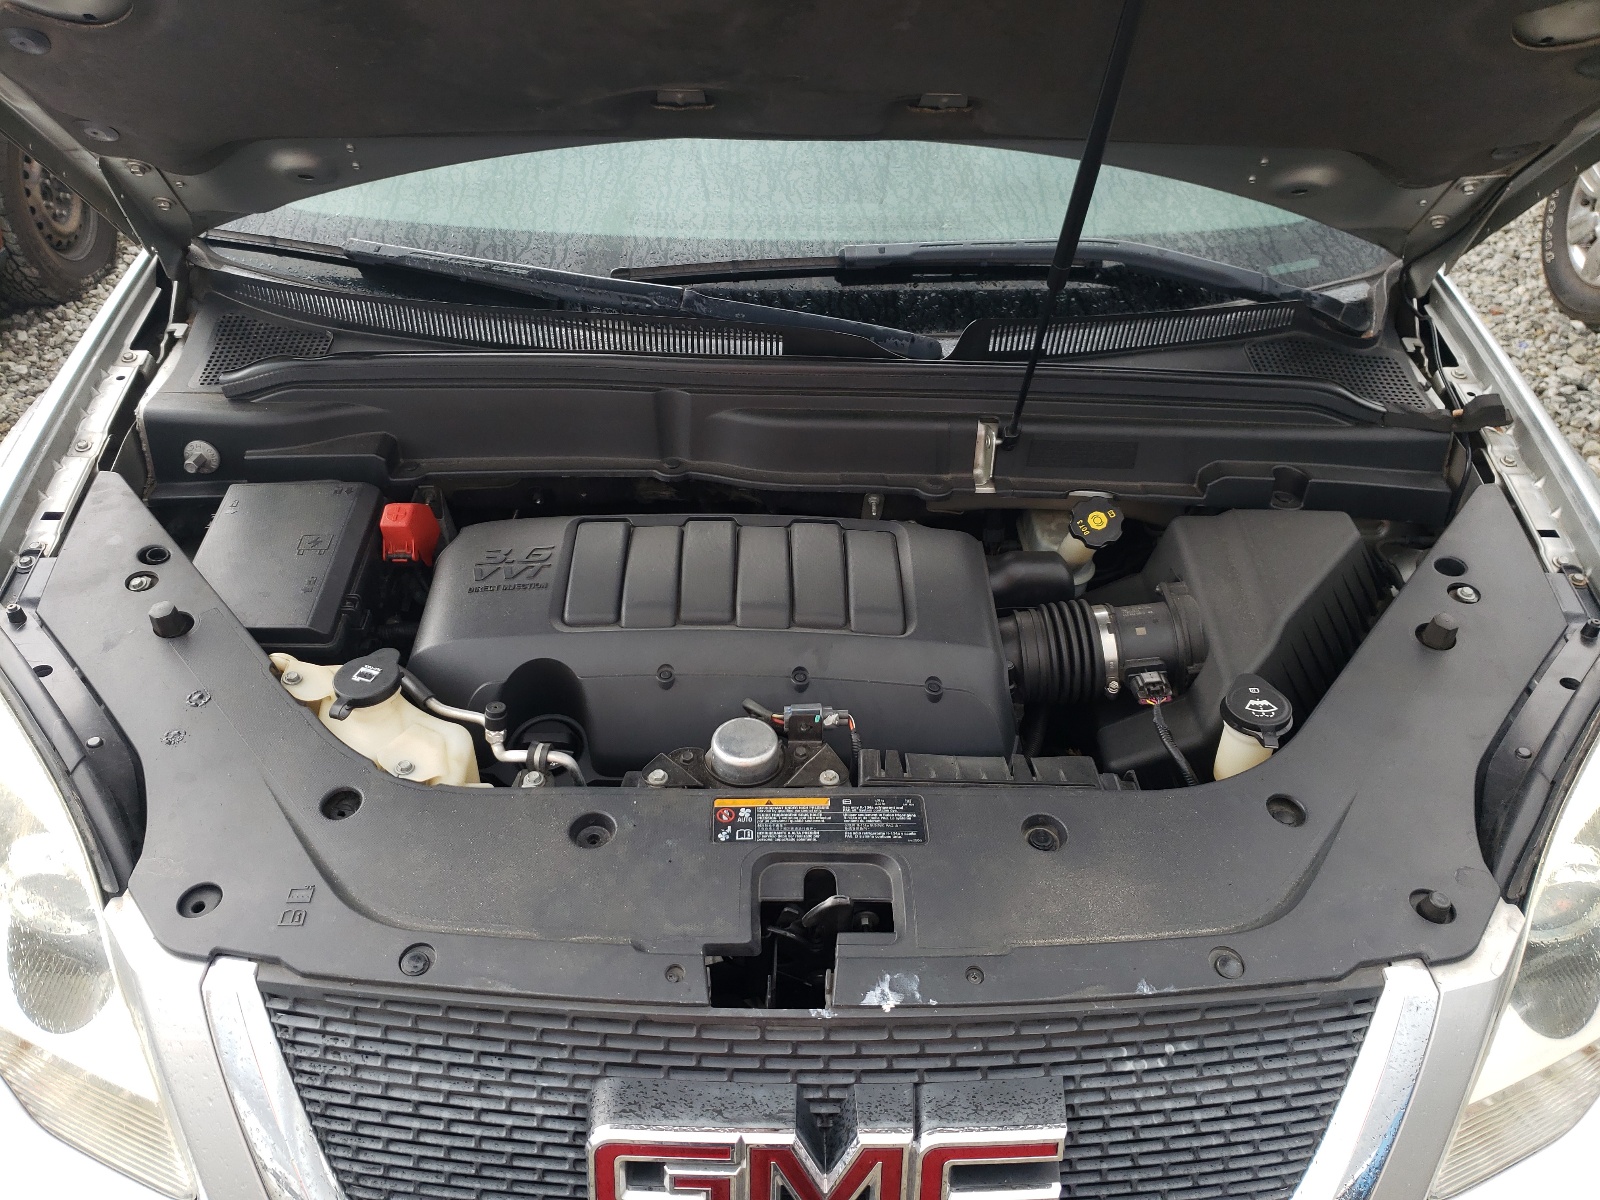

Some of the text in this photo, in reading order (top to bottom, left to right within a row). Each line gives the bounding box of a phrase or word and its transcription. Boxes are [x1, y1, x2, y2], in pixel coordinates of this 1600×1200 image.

[475, 545, 555, 566] 3.6
[473, 563, 552, 581] VVT
[467, 582, 547, 594] DIRECT INJECTION
[587, 1124, 1067, 1199] GMC
